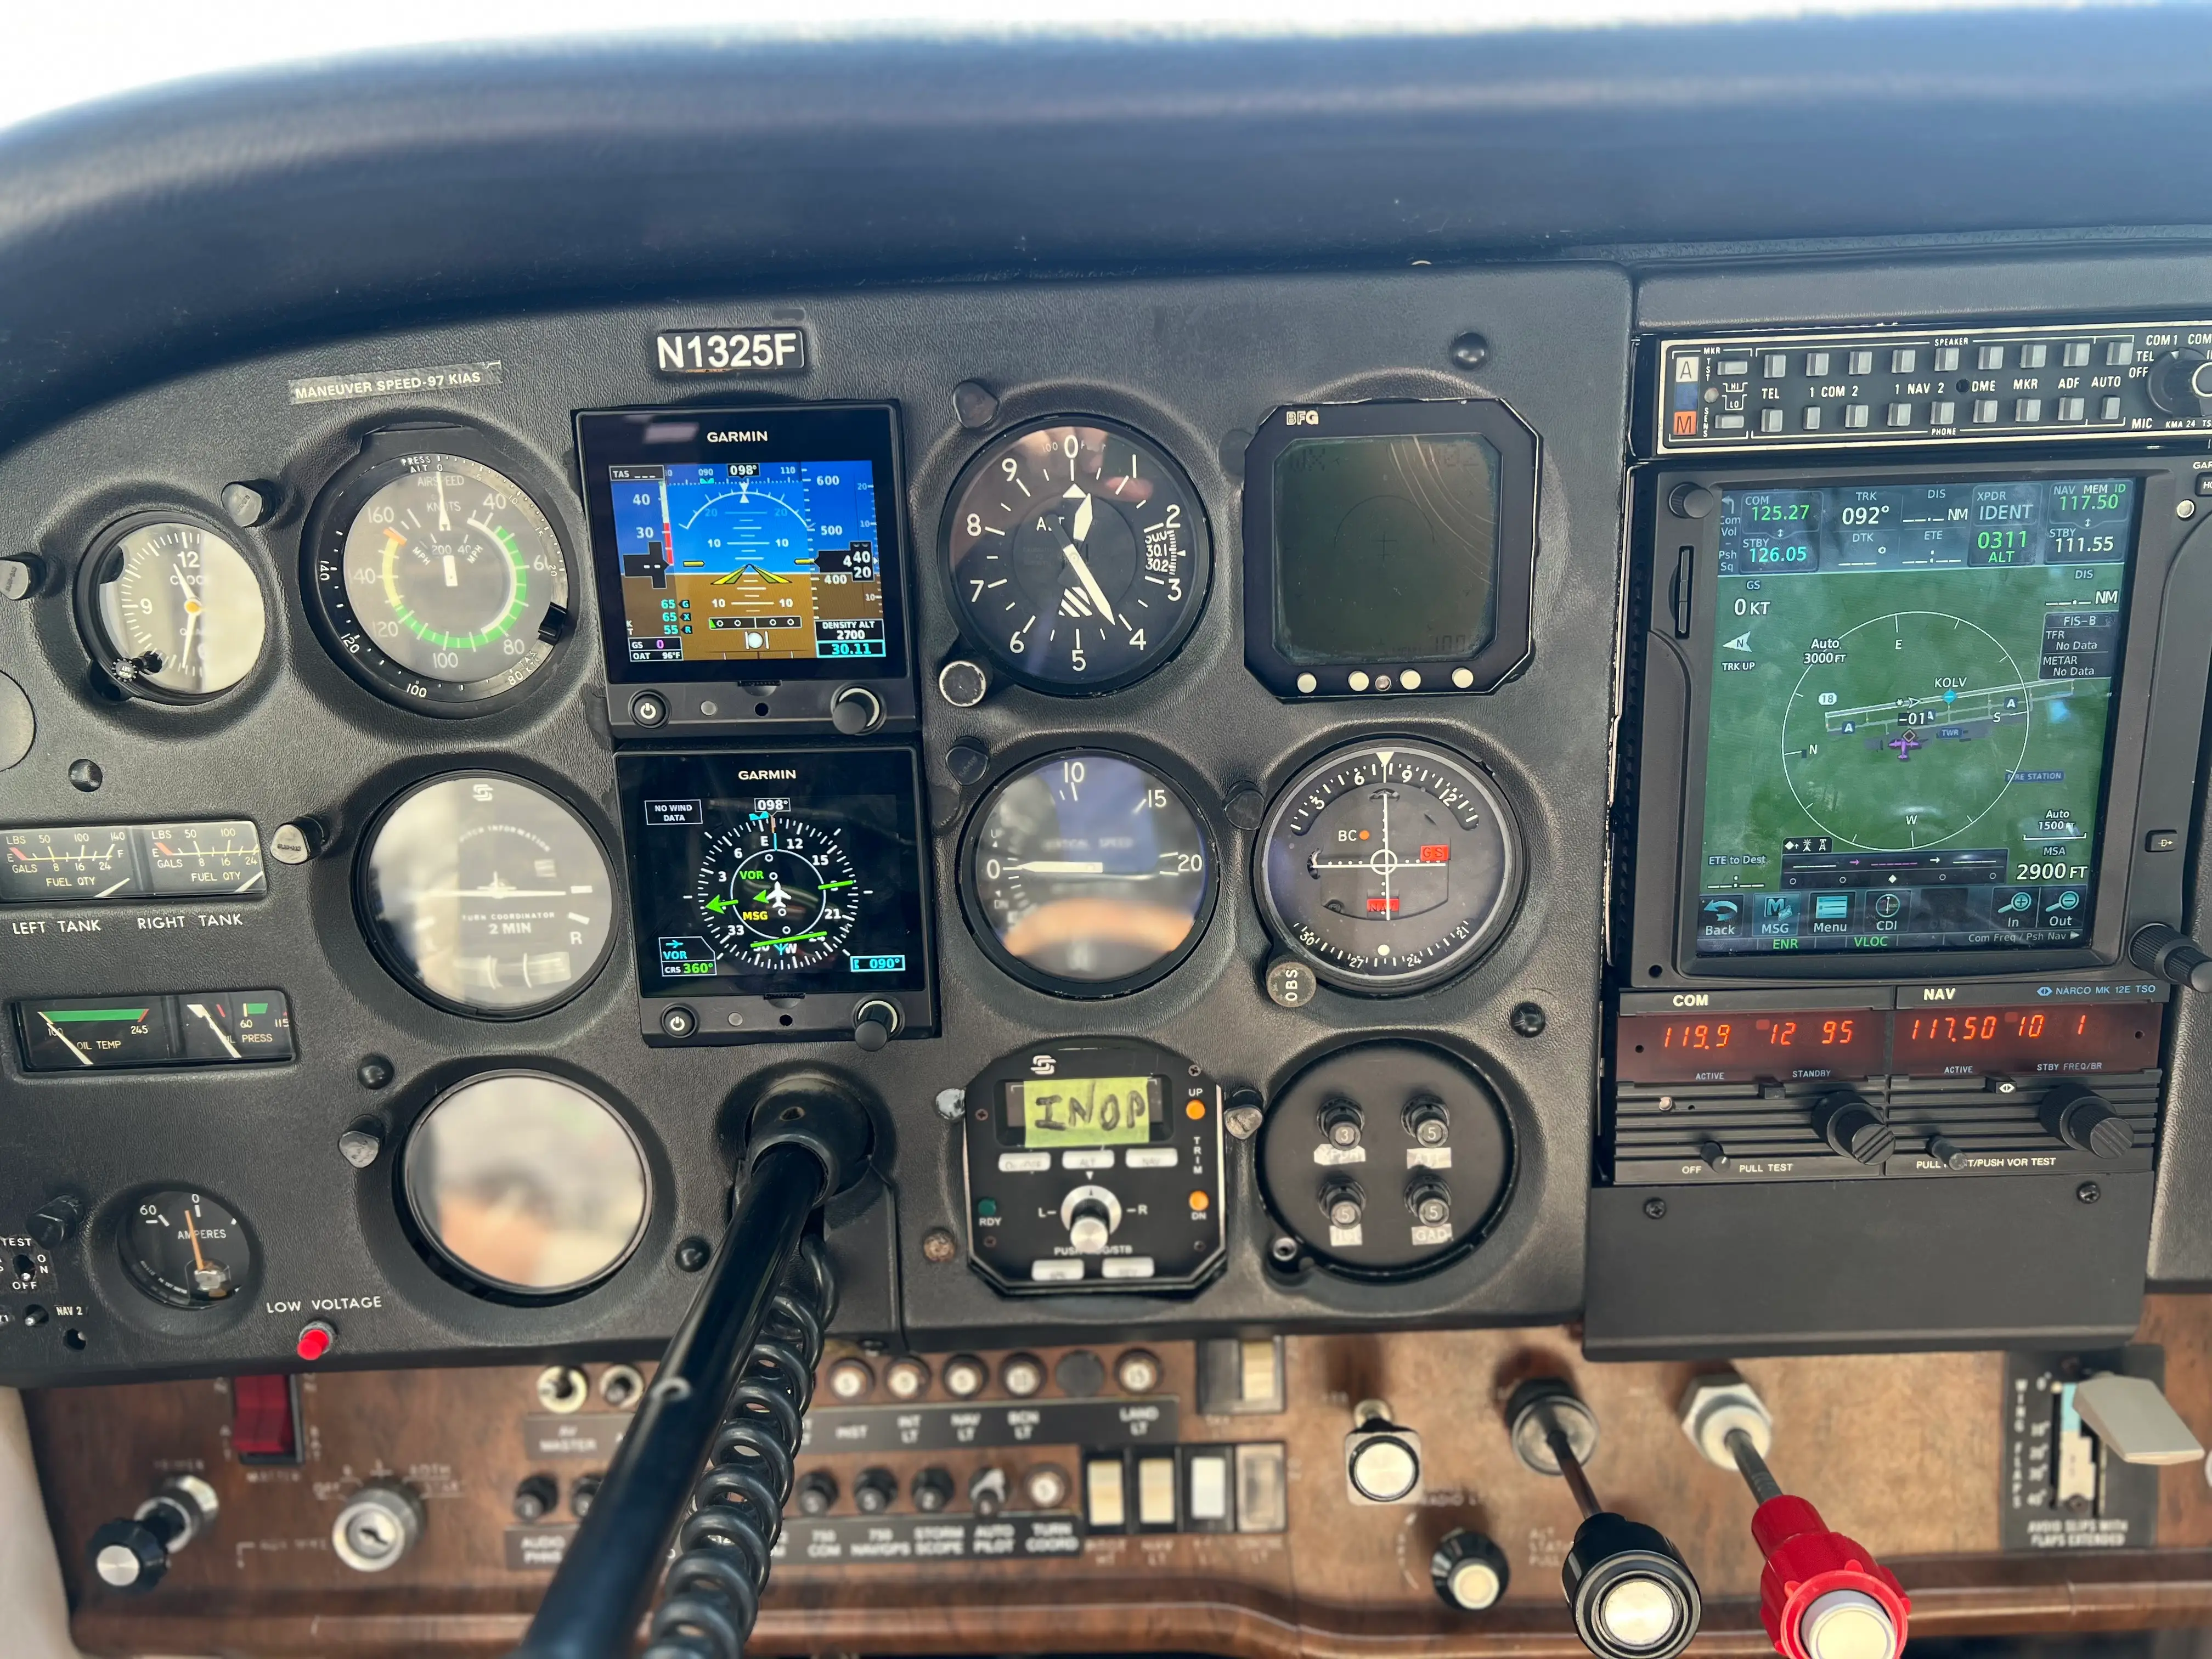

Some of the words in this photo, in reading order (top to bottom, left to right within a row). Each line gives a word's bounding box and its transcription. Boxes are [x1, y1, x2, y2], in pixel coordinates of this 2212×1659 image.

[1934, 337, 1968, 346] SPEAKER
[2146, 335, 2170, 346] COM
[657, 332, 796, 368] N1325F
[2136, 351, 2154, 362] TEL
[2129, 368, 2148, 377] OFF
[295, 382, 373, 400] MANEUVER
[448, 371, 481, 385] KIAS
[1972, 381, 1996, 392] DME
[2013, 379, 2038, 390] MKR
[2058, 377, 2080, 389] ADF
[2091, 376, 2121, 387] AUTO
[1762, 388, 1780, 399] TEL
[1821, 386, 1844, 397] COM
[1908, 383, 1930, 394] NAV
[1286, 410, 1319, 425] BFG
[2132, 418, 2152, 428] MIC
[707, 431, 768, 442] GARMIN
[401, 456, 431, 466] PRESS
[613, 470, 630, 478] TAS
[730, 464, 757, 475] 098°
[417, 475, 464, 487] AIRSPEED
[816, 475, 839, 486] 600
[1928, 489, 1945, 499] DIS
[2054, 486, 2075, 494] NAV
[2084, 484, 2108, 494] MEM
[1746, 496, 1769, 505] COM
[1856, 492, 1877, 501] TRK
[1977, 492, 2006, 501] XPDR
[2061, 494, 2119, 510] 117.50
[427, 501, 461, 511] KNOTS
[1752, 505, 1809, 521] 125.27
[1842, 505, 1889, 524] 092°
[1948, 509, 1968, 520] NM
[1979, 504, 2033, 520] IDENT
[1925, 531, 1943, 540] ETE
[2050, 528, 2076, 538] STBY
[1743, 539, 1769, 548] STBY
[1977, 531, 2027, 549] 0311
[2056, 537, 2113, 553] 111.55
[1146, 544, 1166, 557] 30.1
[1750, 546, 1806, 562] 126.05
[177, 552, 201, 567] 12
[1988, 551, 2015, 563] ALT
[822, 622, 855, 630] DENSITY
[2064, 616, 2096, 626] FIS-B
[837, 630, 865, 640] 2700
[1810, 638, 1839, 649] Auto
[2056, 642, 2069, 650] No
[2073, 641, 2097, 650] Data
[832, 644, 872, 655] 30.11
[433, 653, 458, 668] 100
[633, 652, 650, 660] OAT
[662, 651, 680, 659] 96°F
[1072, 650, 1086, 671] 5
[1804, 653, 1833, 664] 3000
[1835, 654, 1846, 663] FT
[2043, 656, 2078, 665] METAR
[1722, 662, 1740, 671] TRK
[1742, 662, 1755, 670] UP
[1934, 677, 1967, 688] KOLV
[738, 770, 796, 780] GARMIN
[1064, 762, 1085, 783] 10
[758, 799, 788, 810] 098°
[1148, 790, 1166, 808] 15
[6, 836, 26, 844] LBS
[1339, 831, 1356, 841] BC
[2043, 847, 2066, 855] MSA
[157, 860, 183, 868] GALS
[1178, 855, 1202, 872] 20
[1709, 856, 1726, 865] ETE
[1742, 855, 1765, 864] Dest
[13, 864, 37, 873] GALS
[2017, 863, 2066, 880] 2900
[2070, 866, 2087, 878] FT
[740, 870, 764, 880] VOR
[46, 877, 72, 887] FUEL
[77, 877, 95, 886] QTY
[138, 916, 185, 929] RIGHT
[199, 914, 243, 927] TANK
[743, 911, 768, 921] MSG
[13, 921, 44, 934] LEFT
[58, 920, 101, 932] TANK
[489, 924, 498, 934] 2
[503, 923, 531, 933] MIN
[1706, 926, 1735, 935] Back
[1762, 924, 1789, 933] MSG
[1814, 923, 1847, 932] Menu
[1876, 921, 1897, 931] CDI
[1773, 939, 1798, 949] ENR
[1854, 936, 1888, 946] VLOC
[663, 950, 687, 960] VOR
[684, 963, 713, 973] 360°
[870, 958, 900, 969] 090°
[1286, 969, 1297, 1001] OBS
[2056, 985, 2091, 995] NARCO
[2095, 985, 2110, 994] MK
[2115, 985, 2130, 994] 12E
[2135, 985, 2155, 993] TSO
[1923, 988, 1956, 1000] NAV
[1673, 995, 1708, 1007] COM
[131, 1025, 148, 1034] 245
[1912, 1016, 1997, 1042] 117.50
[242, 1034, 272, 1043] PRESS
[77, 1041, 92, 1049] OIL
[96, 1041, 121, 1049] TEMP
[2063, 1062, 2102, 1070] FREQ/BR
[1792, 1069, 1831, 1077] STANDBY
[1035, 1080, 1145, 1130] INOP
[1682, 1165, 1701, 1173] OFF
[1739, 1164, 1763, 1172] PULL
[1768, 1163, 1793, 1171] TEST
[1916, 1160, 1941, 1169] PULL
[2007, 1158, 2028, 1167] VOR
[2031, 1158, 2056, 1166] TEST
[979, 1218, 1001, 1226] RDY
[178, 1229, 226, 1240] AMPERES
[267, 1301, 301, 1313] LOW
[312, 1296, 382, 1310] VOLTAGE
[56, 1307, 72, 1315] NAV
[77, 1307, 82, 1315] 2
